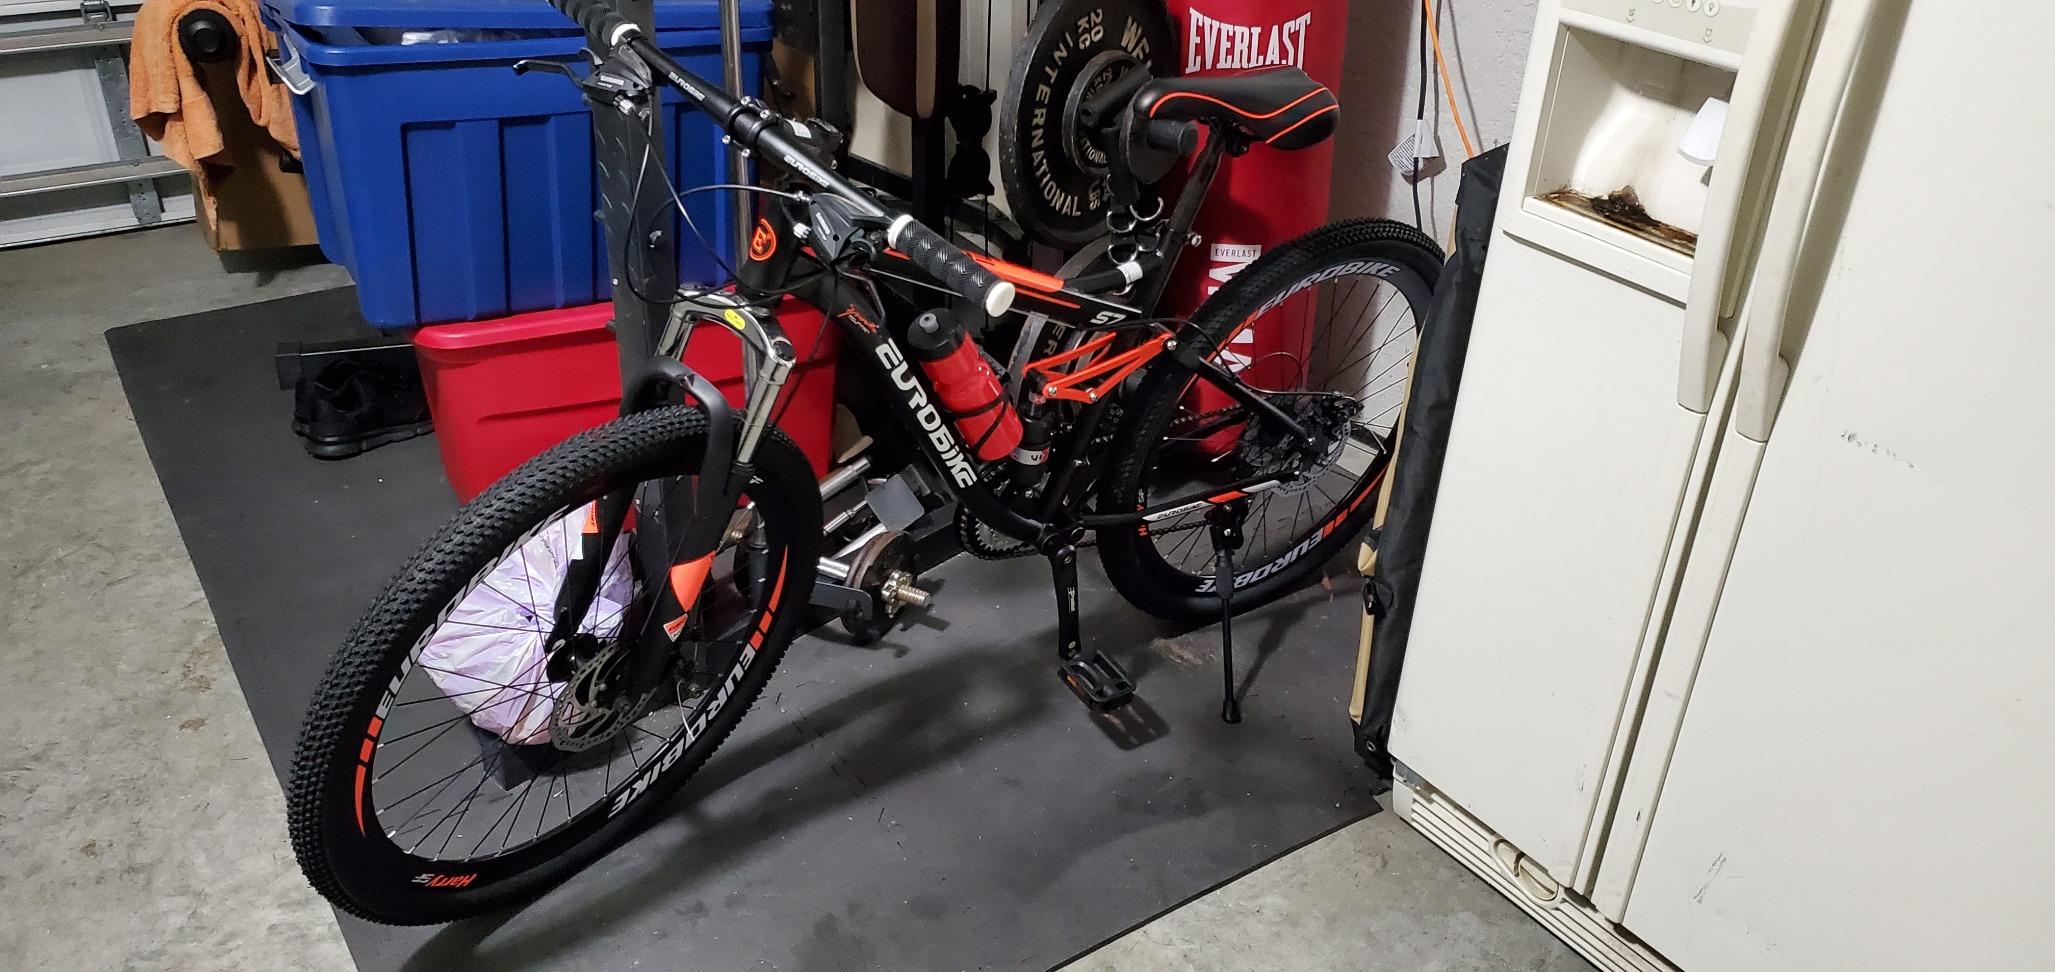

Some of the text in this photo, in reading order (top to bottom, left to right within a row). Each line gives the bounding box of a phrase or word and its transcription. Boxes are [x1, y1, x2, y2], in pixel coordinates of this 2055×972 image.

[1090, 7, 1105, 43] 20
[1185, 6, 1311, 74] EVERLAST
[1031, 31, 1082, 217] INTERNATIONAL
[1215, 248, 1257, 258] EVERLAST
[1089, 310, 1127, 326] S7
[1254, 261, 1401, 321] EUROBIKE
[608, 643, 756, 819] EUROBIKE
